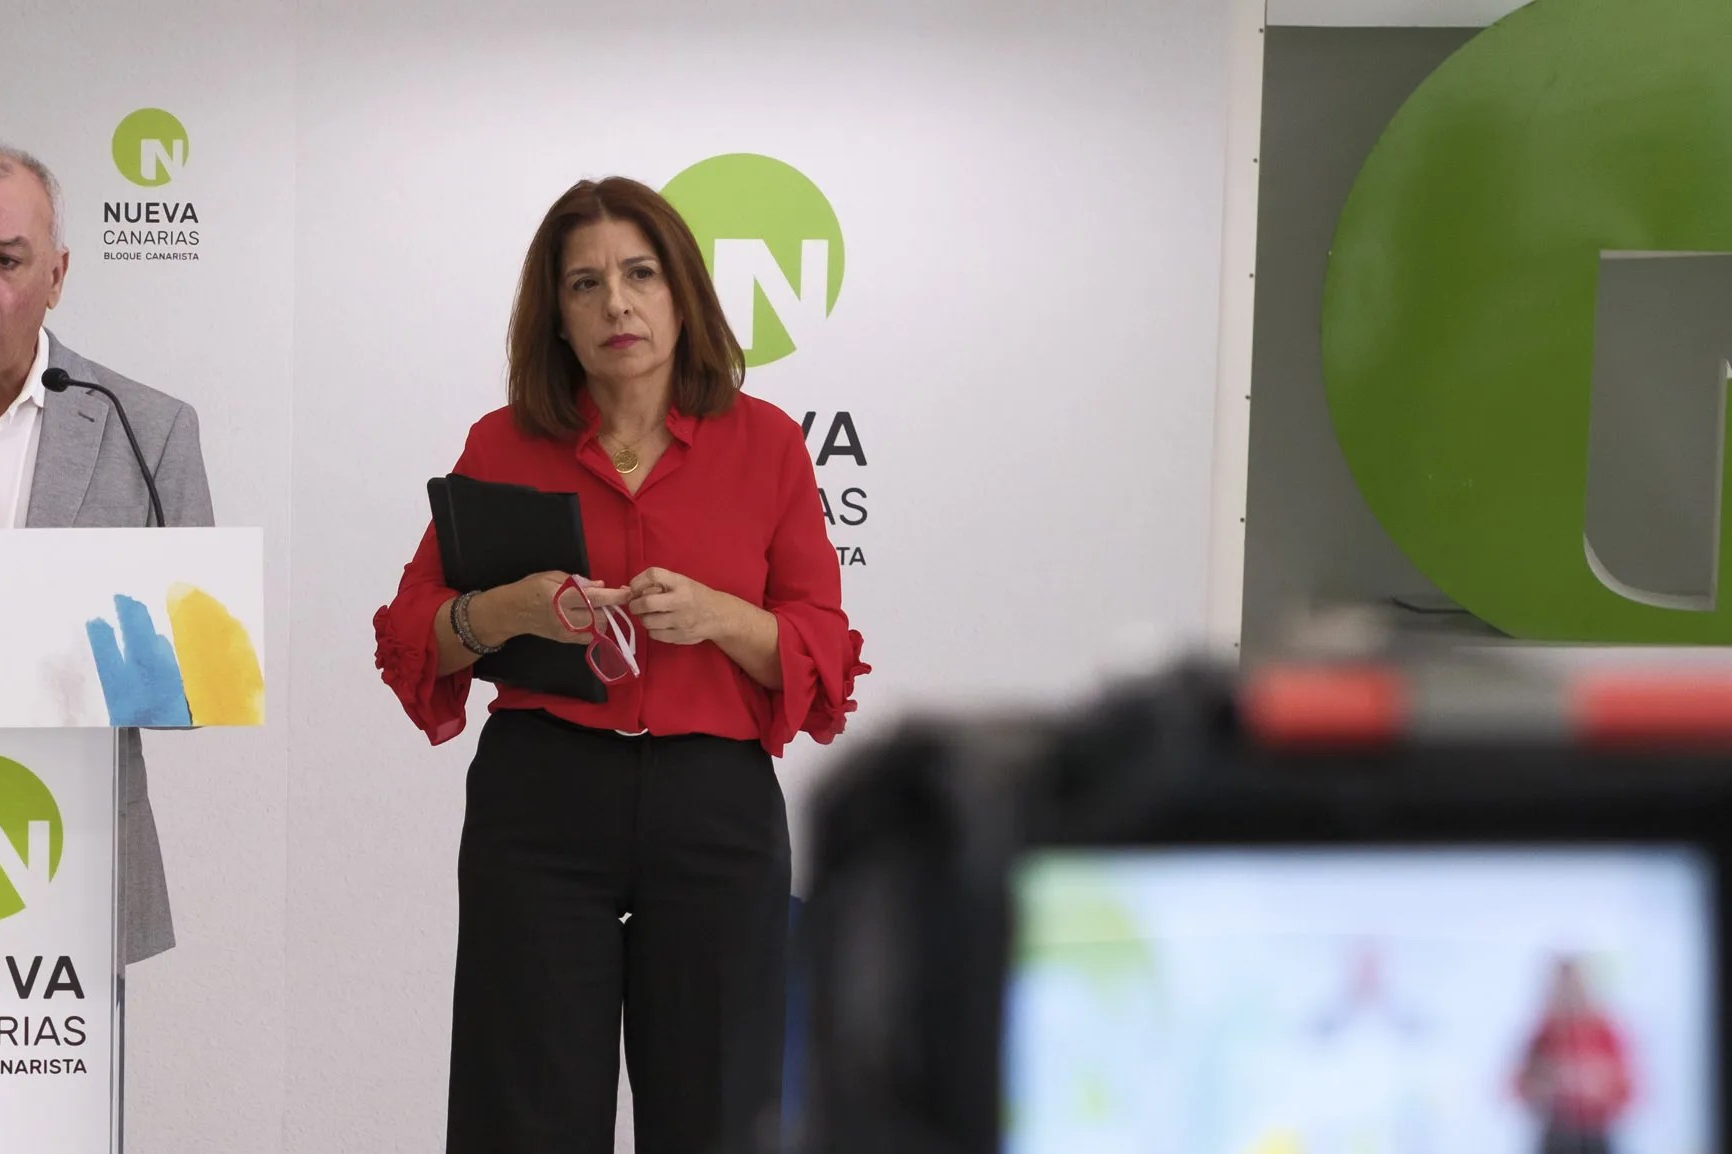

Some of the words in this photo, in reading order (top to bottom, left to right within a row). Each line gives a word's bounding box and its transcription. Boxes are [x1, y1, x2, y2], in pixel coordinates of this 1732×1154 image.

[104, 202, 199, 223] NUEVA
[103, 230, 200, 245] CANARIAS
[104, 252, 142, 261] BLOQUE
[146, 252, 199, 261] CANARISTA
